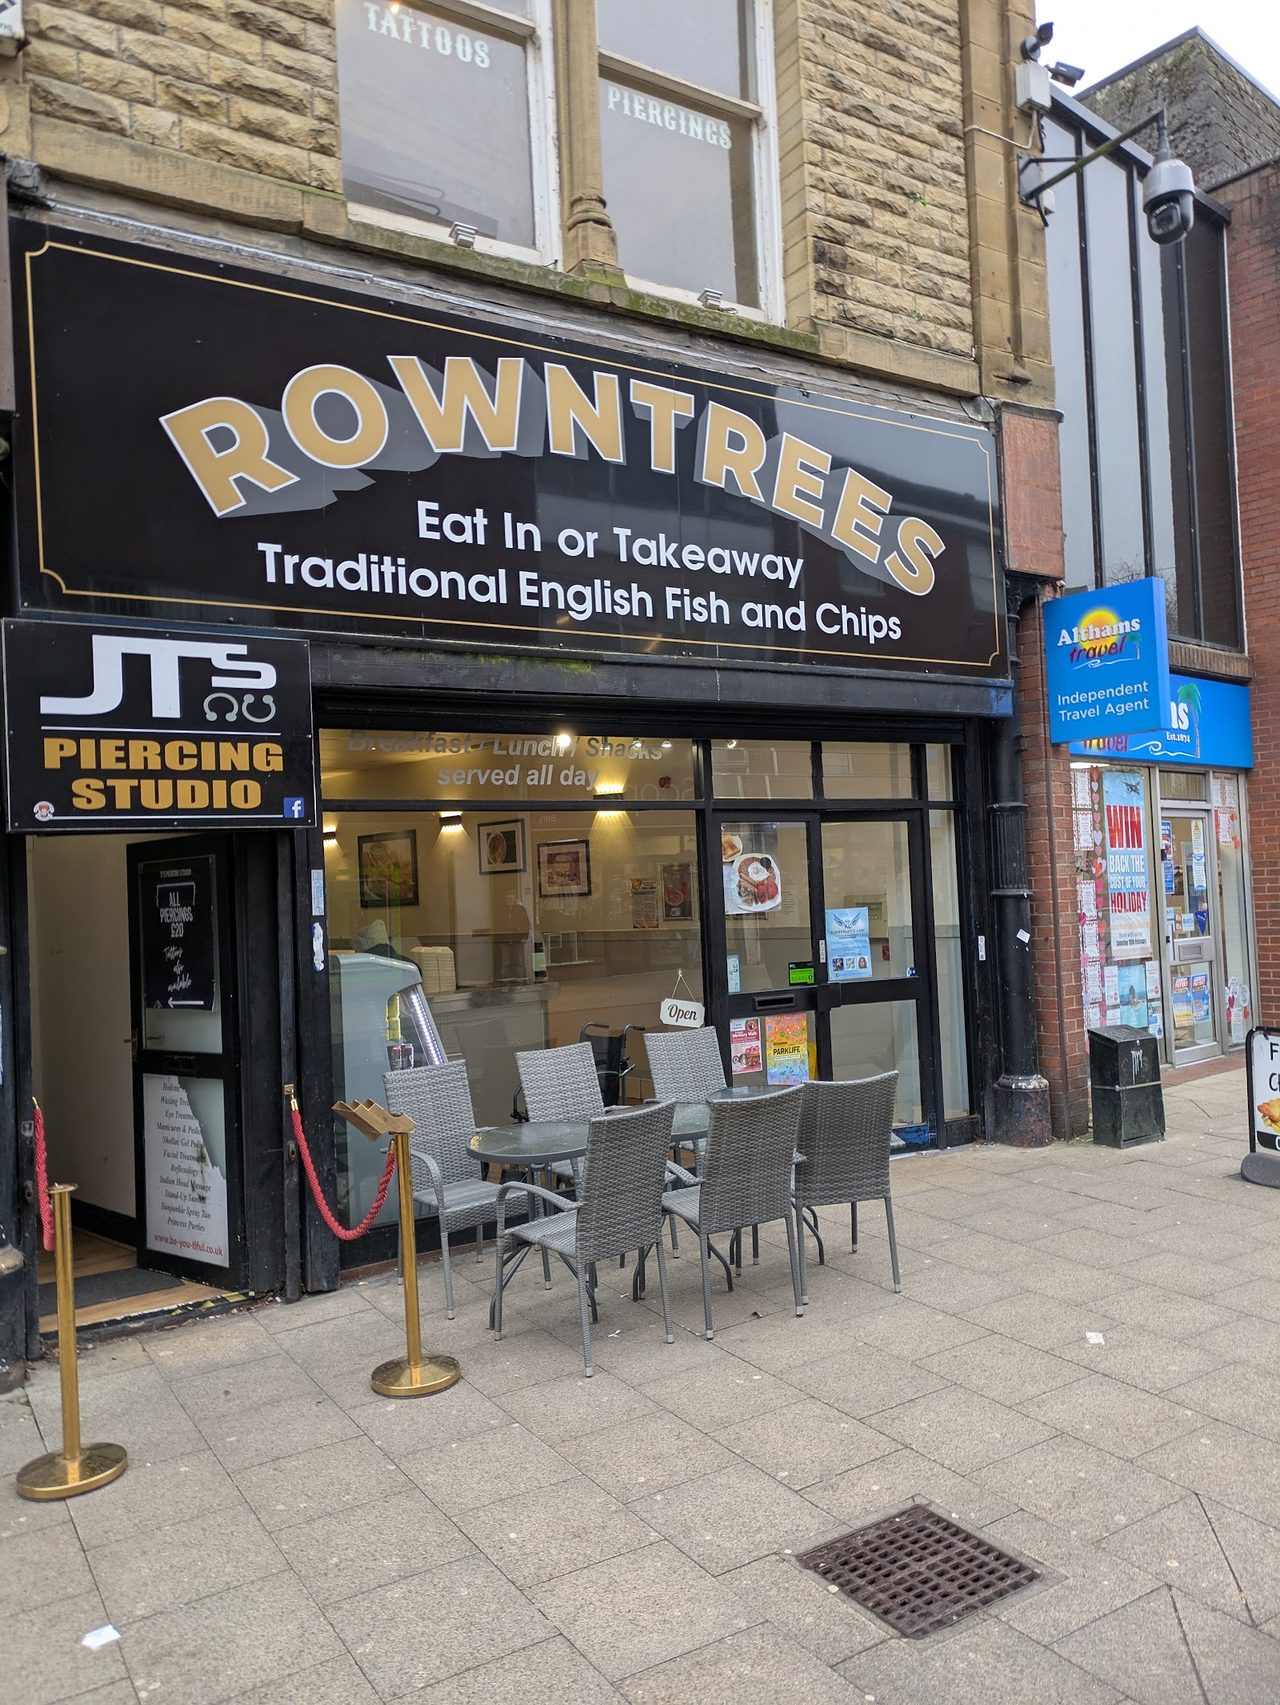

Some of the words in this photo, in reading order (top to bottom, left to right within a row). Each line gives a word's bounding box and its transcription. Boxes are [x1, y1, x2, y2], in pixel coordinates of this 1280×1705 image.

[363, 2, 490, 69] TATTOOS
[607, 85, 732, 150] PIERCINGS
[159, 355, 945, 596] ROWNTREES
[417, 500, 488, 545] Eat
[503, 512, 542, 551] In
[557, 528, 598, 558] or
[613, 526, 804, 589] Takeaway
[257, 542, 507, 604] Traditional
[519, 569, 653, 621] English
[665, 586, 730, 625] Fish
[741, 599, 806, 631] and
[815, 602, 902, 644] Chips
[1057, 617, 1141, 646] Althams
[1069, 635, 1127, 663] travel
[1057, 680, 1149, 706] Independent
[1059, 704, 1100, 721] Travel
[1105, 698, 1149, 716] Agent
[43, 737, 284, 772] PIERCING
[493, 733, 566, 758] Lunch
[587, 736, 663, 760] Snacks
[437, 764, 520, 786] served
[526, 765, 553, 785] all
[559, 765, 600, 791] day
[71, 778, 262, 810] STUDIO
[1106, 805, 1143, 849] WIN
[1109, 855, 1130, 873] BACK
[1131, 855, 1145, 872] THE
[160, 907, 193, 923] PIERCINGS
[1111, 892, 1147, 913] HOLIDAY
[171, 923, 184, 938] £20
[667, 1004, 697, 1022] Open
[773, 1046, 800, 1056] PARKLIFE
